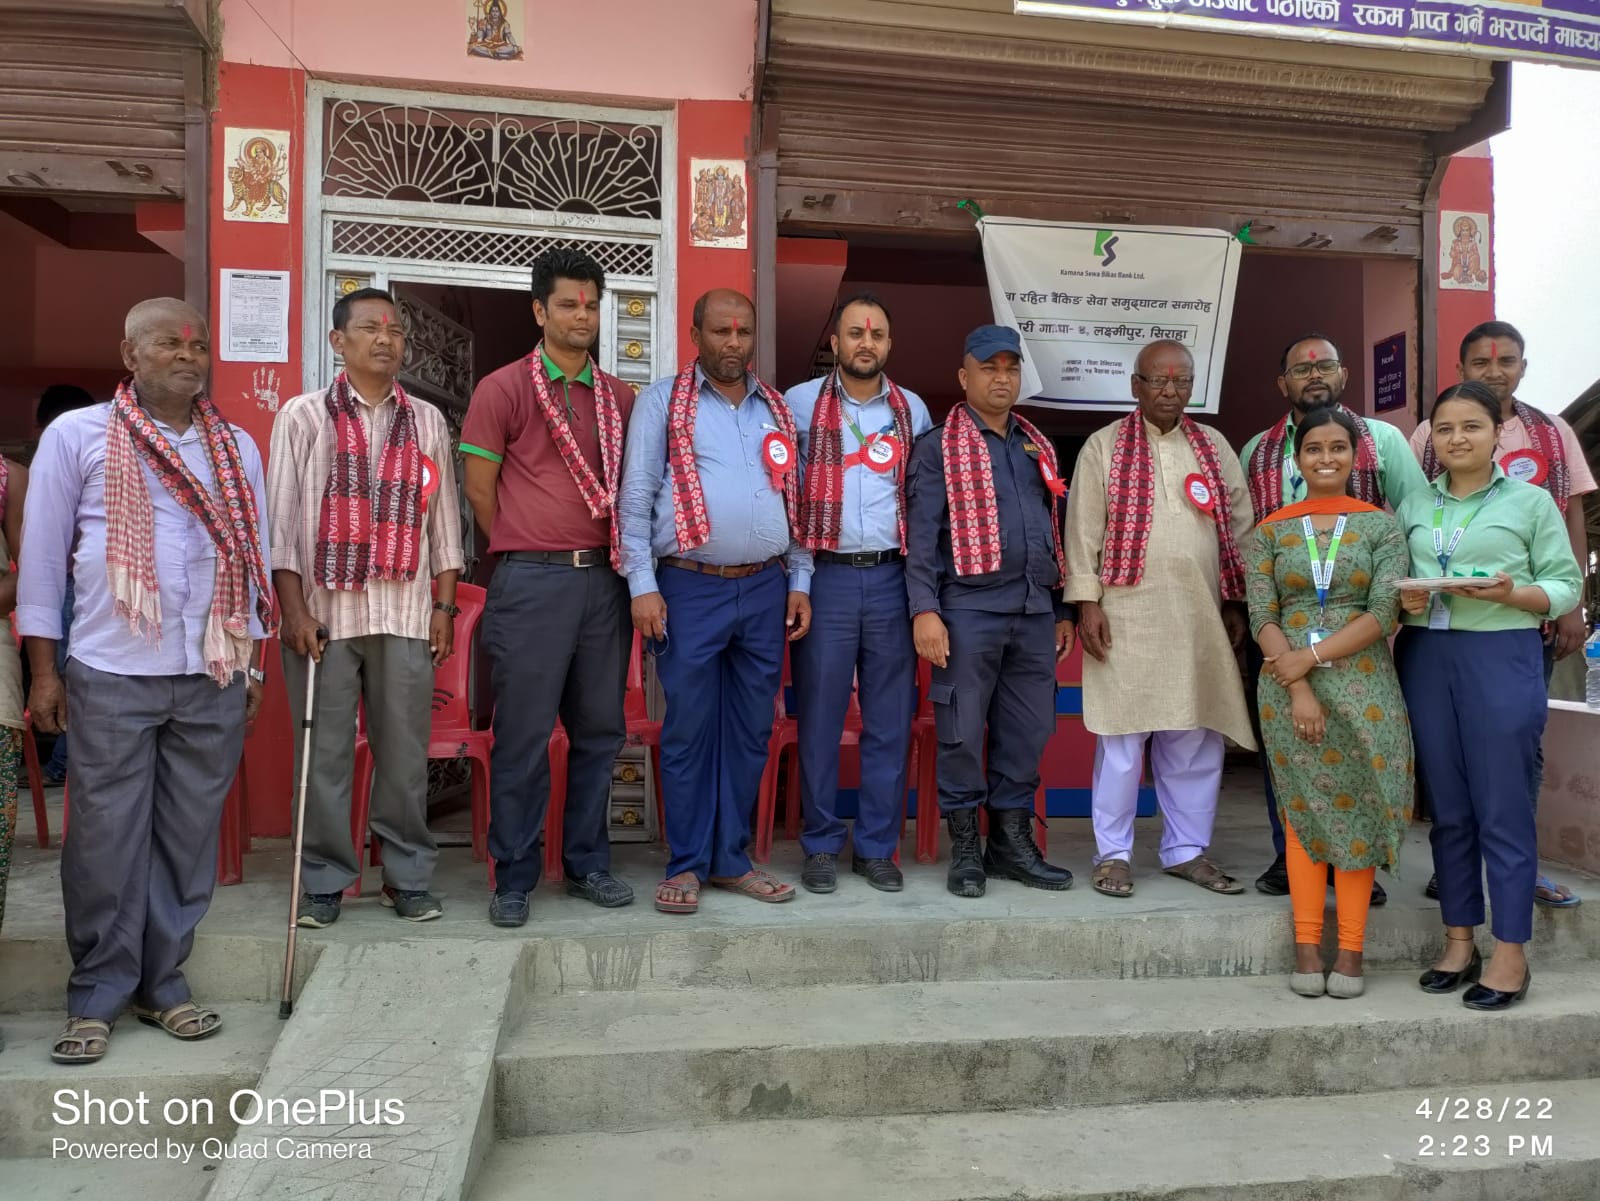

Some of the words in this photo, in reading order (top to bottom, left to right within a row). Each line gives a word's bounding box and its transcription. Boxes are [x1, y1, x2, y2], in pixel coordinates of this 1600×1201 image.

[1352, 4, 1405, 28] रकम
[1554, 26, 1600, 51] माध्य
[1060, 269, 1084, 277] Kamana
[1085, 270, 1100, 278] Sewa
[1134, 272, 1145, 280] Ltd.
[1020, 290, 1048, 305] रहित
[1051, 291, 1083, 305] बैंकिङ
[1087, 294, 1108, 306] सेवा
[1172, 299, 1212, 313] समारोह
[1150, 326, 1188, 341] सिराहा
